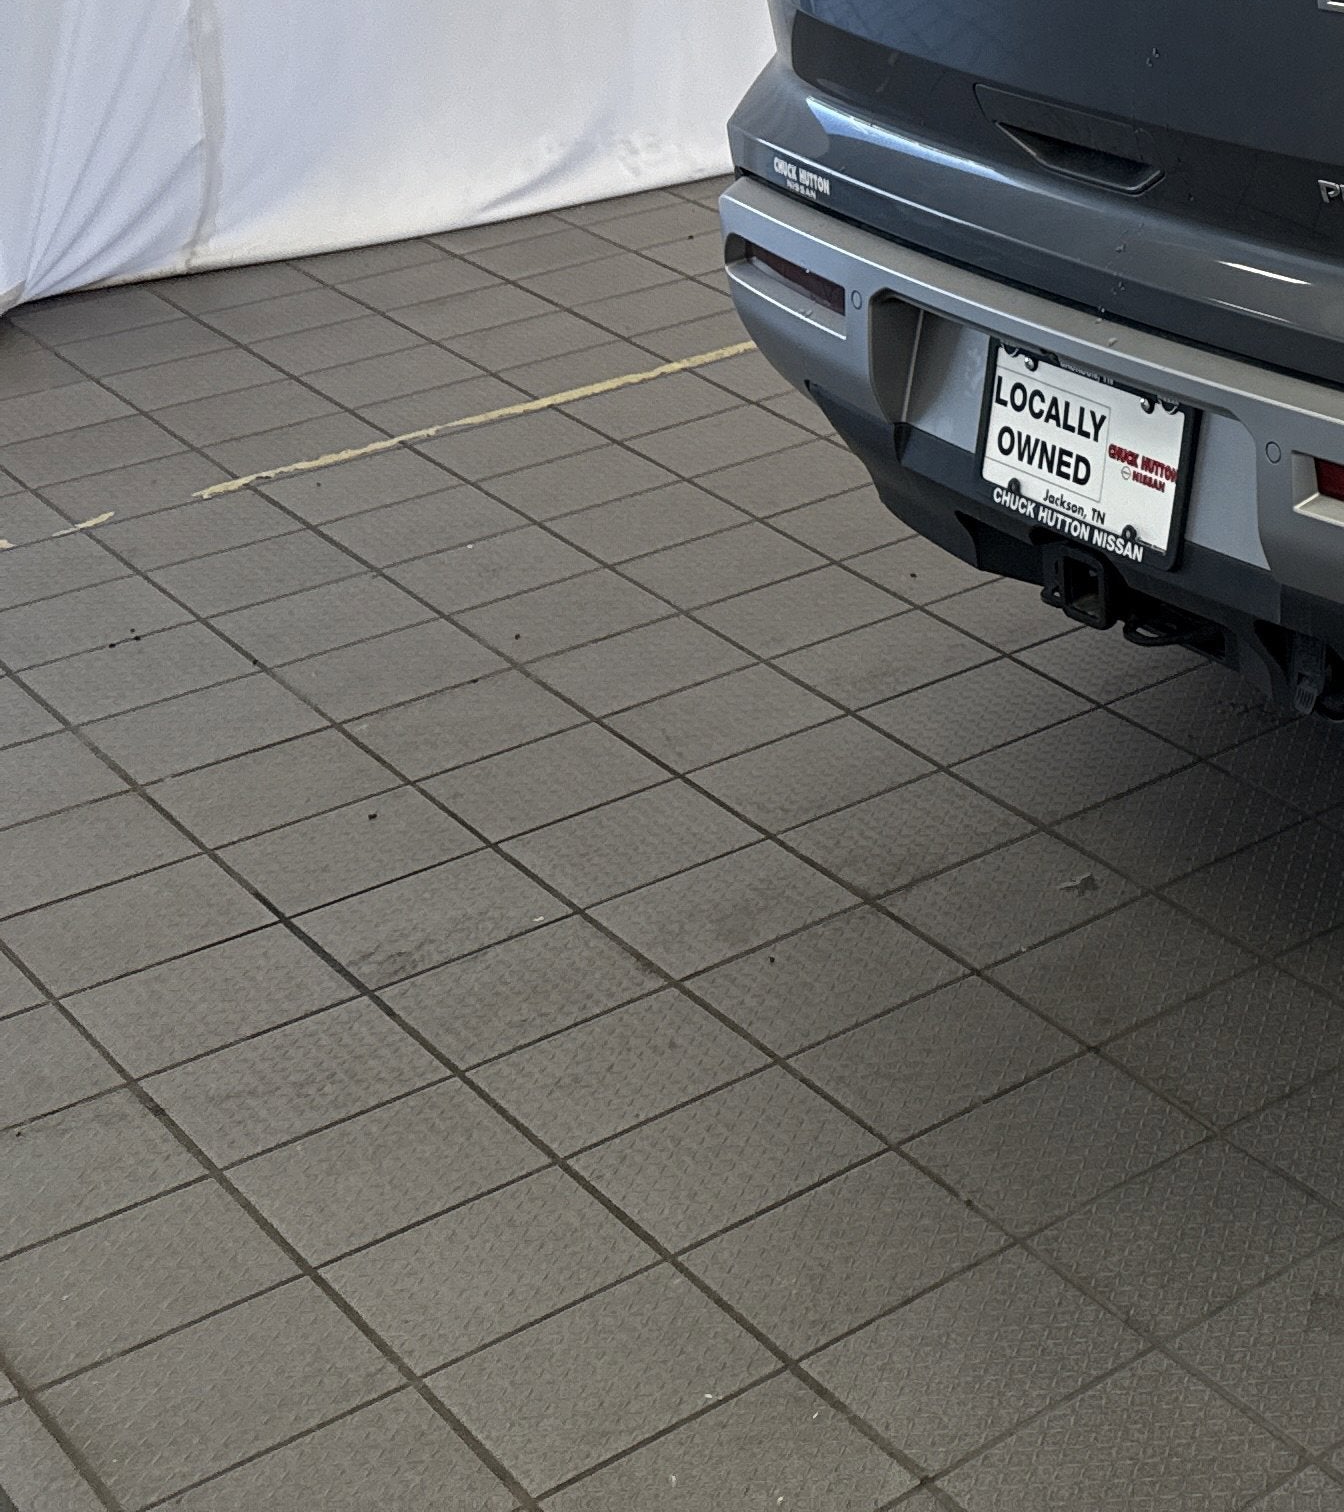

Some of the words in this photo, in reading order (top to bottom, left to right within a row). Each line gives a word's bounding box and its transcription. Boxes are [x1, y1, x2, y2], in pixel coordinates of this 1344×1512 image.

[799, 168, 830, 195] HUTTON
[994, 375, 1107, 443] LOCALLY
[997, 426, 1092, 486] OWNED
[1108, 443, 1139, 468] CHUCK
[1141, 455, 1178, 483] HUTTON
[1132, 470, 1165, 493] NISSAN
[993, 487, 1036, 519] CHUCK
[1038, 506, 1090, 542] HUTTON
[1092, 529, 1144, 563] NISSAN
[1042, 489, 1088, 519] Jackson,
[1092, 508, 1106, 525] TN
